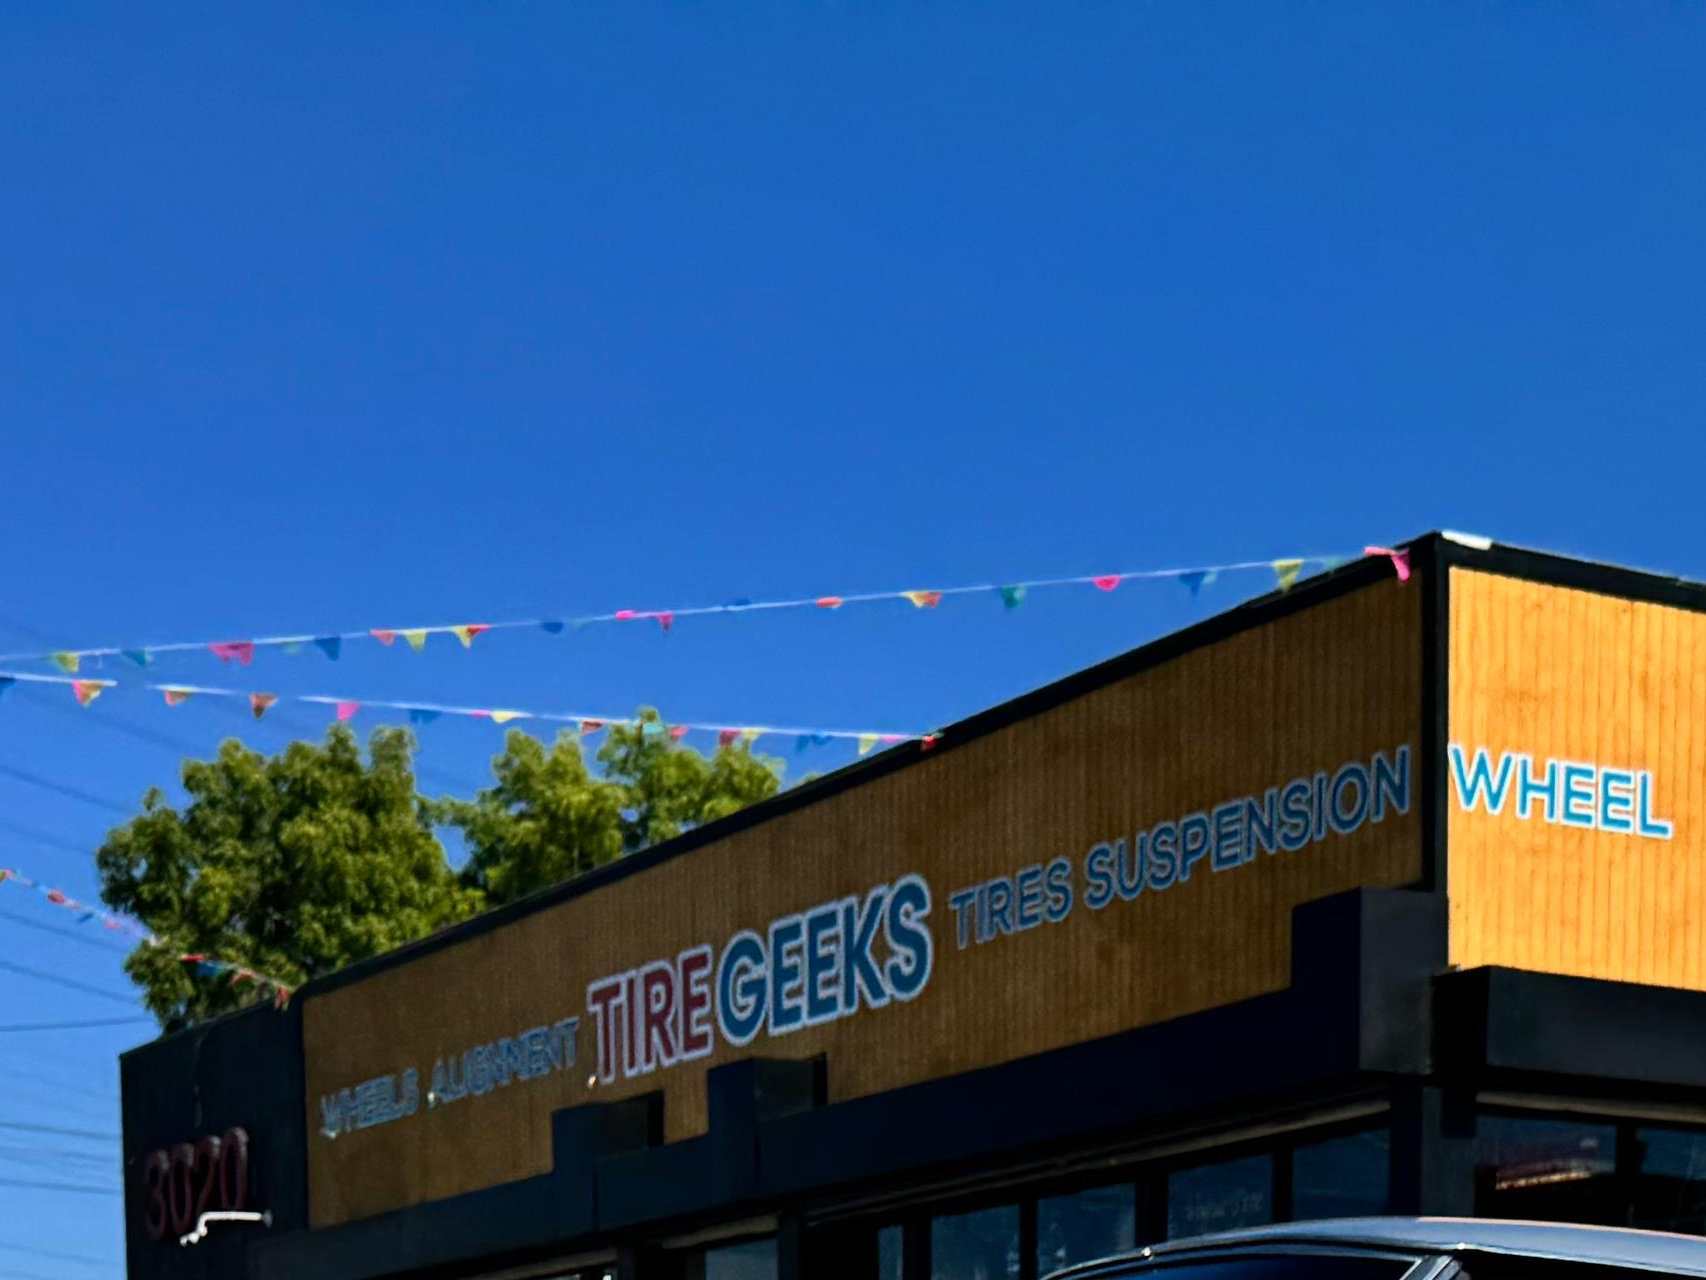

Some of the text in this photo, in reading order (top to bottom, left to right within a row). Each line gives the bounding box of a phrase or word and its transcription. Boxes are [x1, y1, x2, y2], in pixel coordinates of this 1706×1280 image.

[1447, 743, 1673, 840] WHEEL
[319, 1067, 420, 1139] WHEELS
[430, 1015, 580, 1104] ALIGNMENT
[949, 857, 1072, 950] TIRES
[1084, 744, 1412, 910] SUSPENSION
